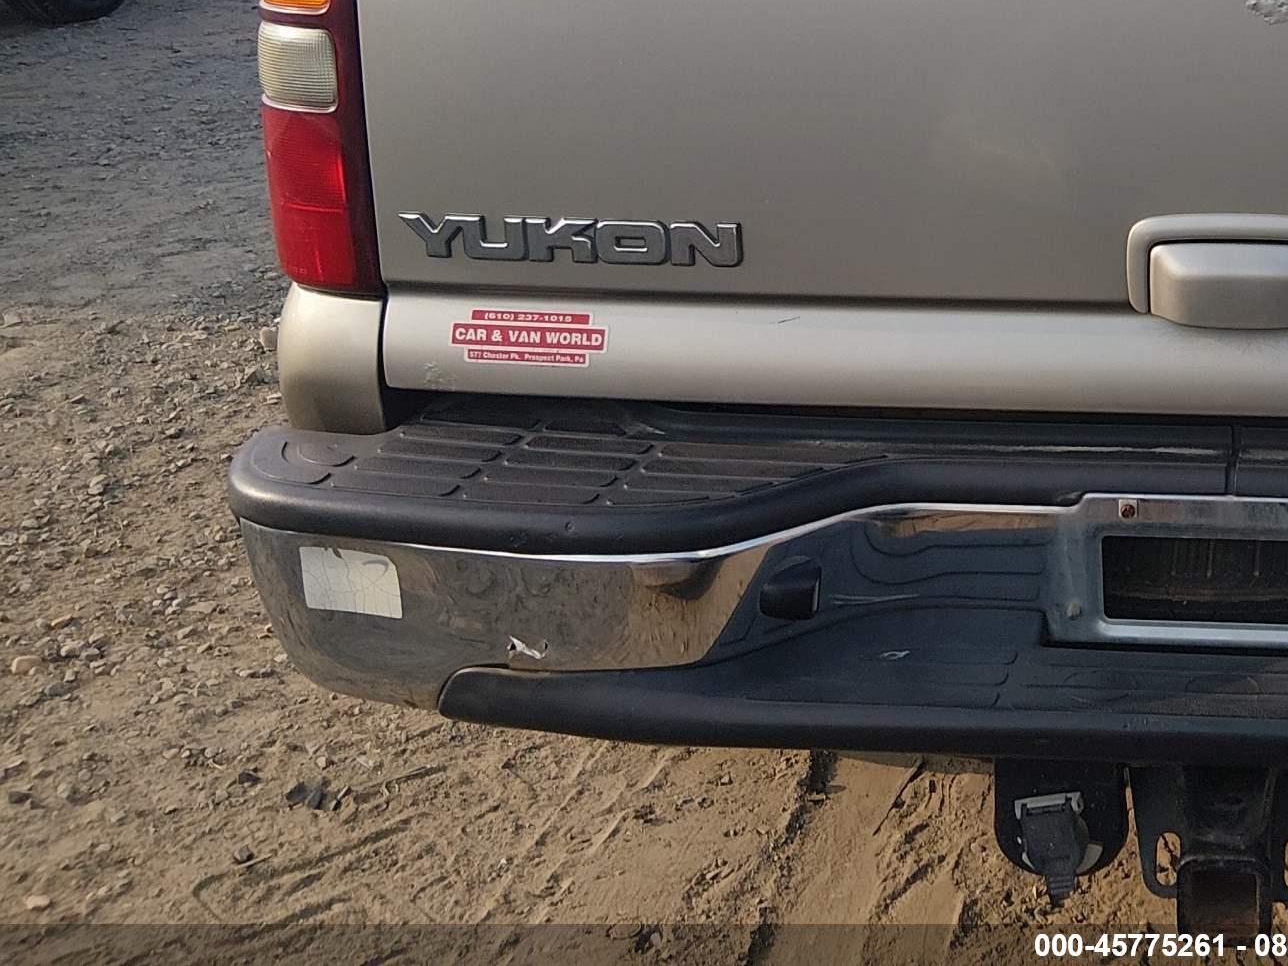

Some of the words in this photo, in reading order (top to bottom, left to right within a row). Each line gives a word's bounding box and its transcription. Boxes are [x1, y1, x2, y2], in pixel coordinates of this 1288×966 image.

[398, 212, 741, 267] YUKON
[484, 312, 515, 321] (610)
[455, 327, 487, 341] CAR
[491, 330, 503, 342] &
[508, 330, 541, 343] VAN
[545, 332, 603, 346] WORLD
[524, 353, 554, 362] Prospect
